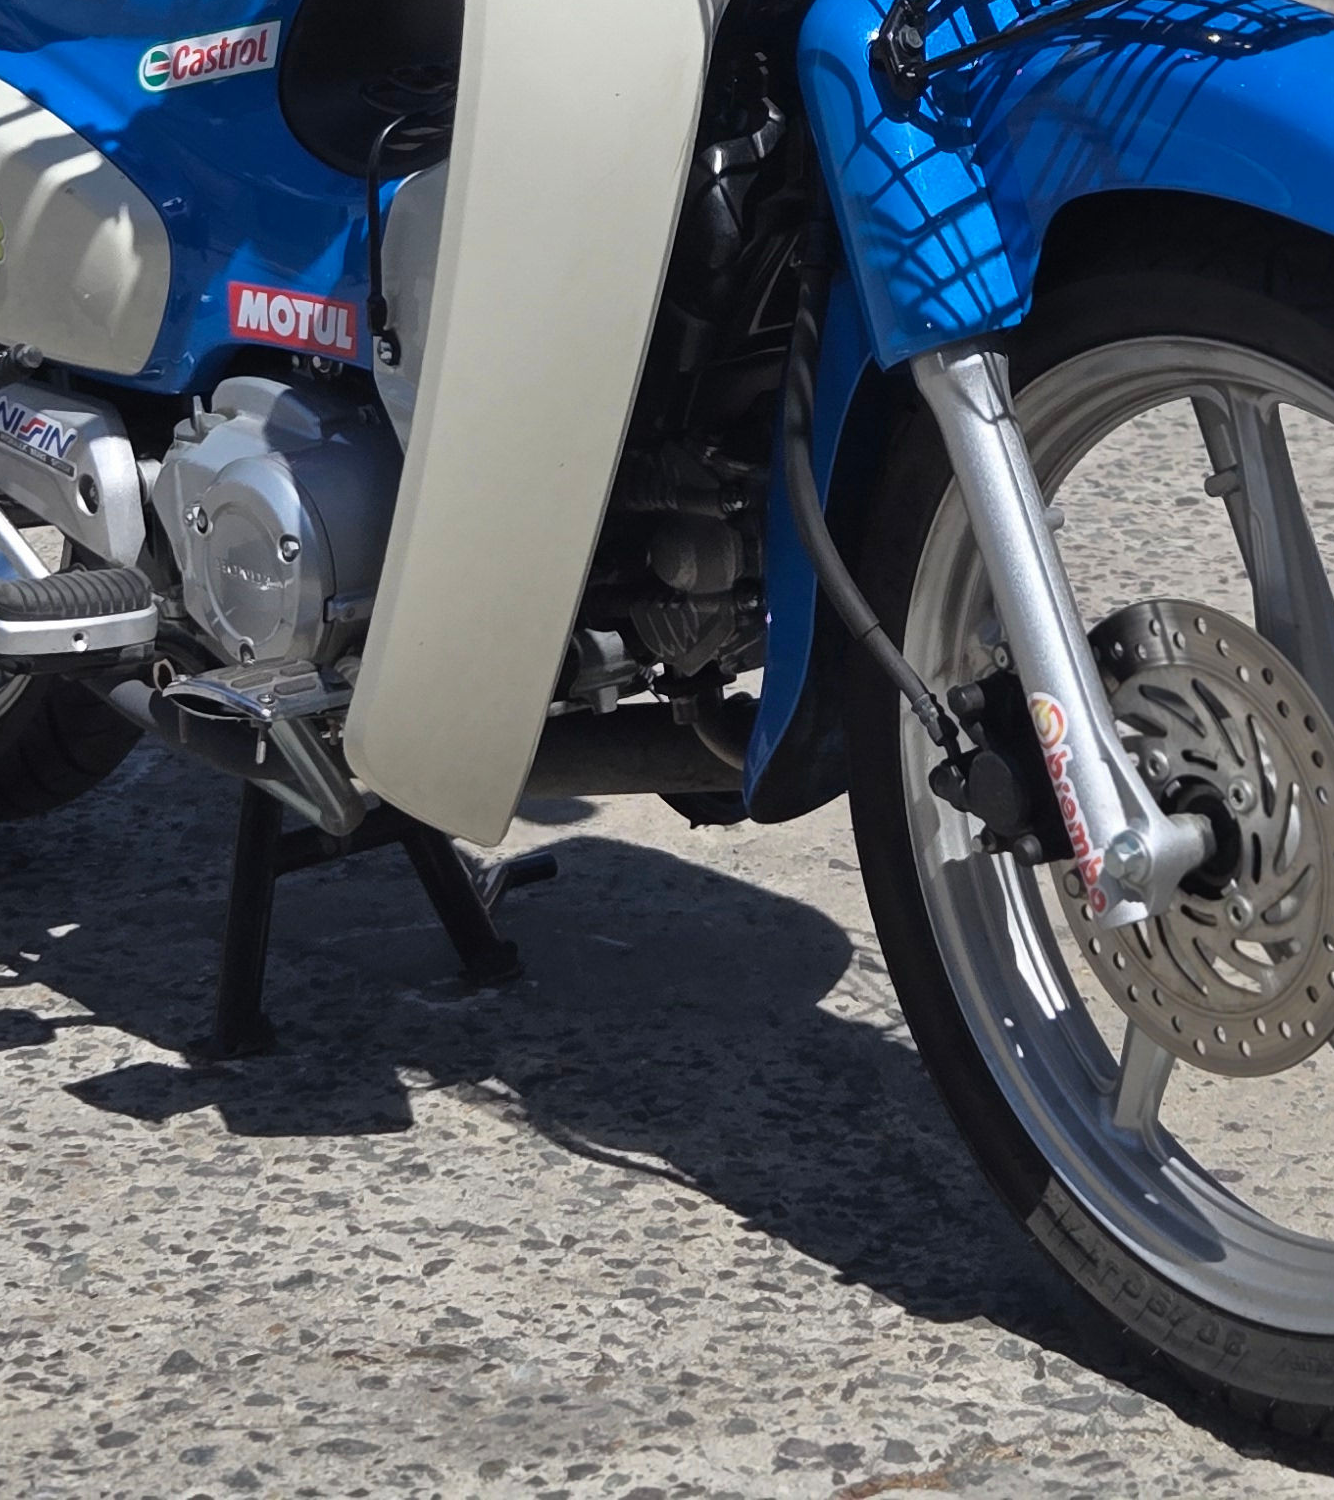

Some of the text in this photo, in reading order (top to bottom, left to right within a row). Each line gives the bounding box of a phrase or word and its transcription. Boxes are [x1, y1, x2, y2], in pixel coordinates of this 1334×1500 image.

[172, 29, 268, 80] Castrol
[237, 289, 353, 350] MOTUL
[1046, 750, 1107, 913] brembo
